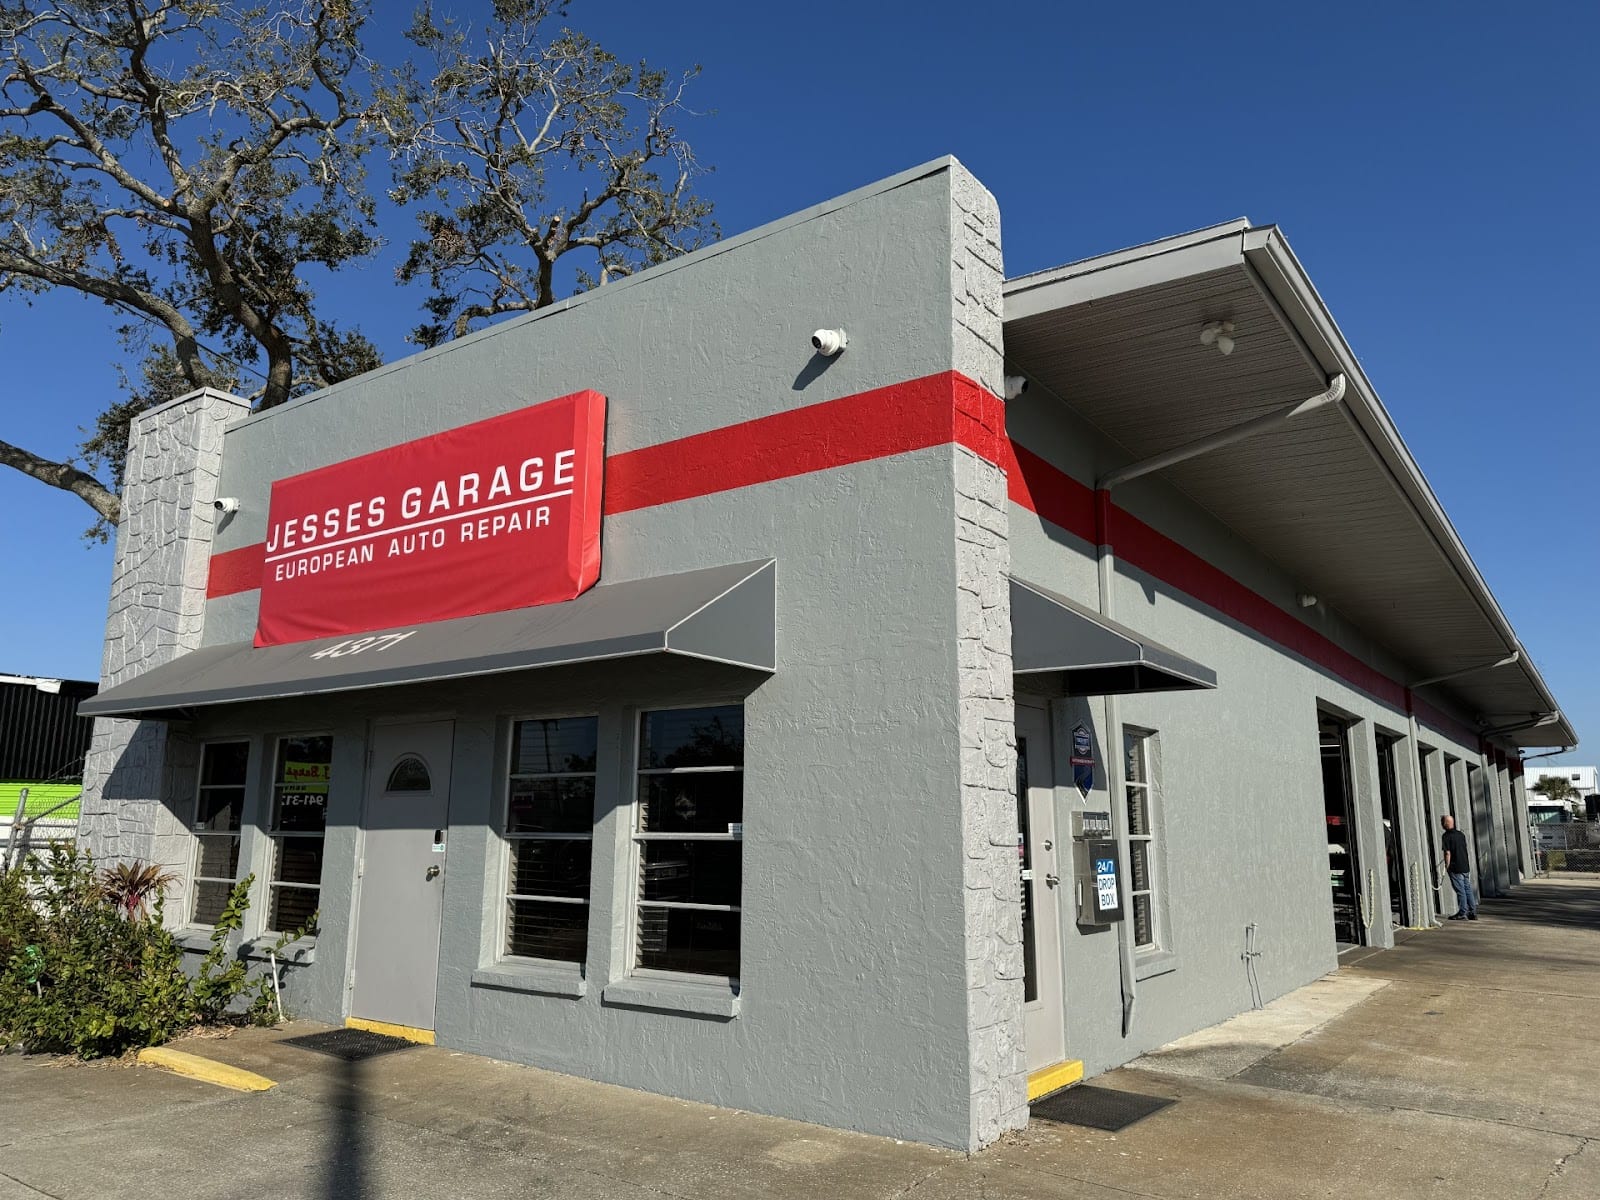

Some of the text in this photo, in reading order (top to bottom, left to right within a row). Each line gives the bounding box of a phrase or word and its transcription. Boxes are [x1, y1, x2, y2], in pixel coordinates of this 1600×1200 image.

[265, 448, 576, 553] JESSES GARAGE
[275, 506, 551, 582] EUROPEAN AUTO REPAIR
[309, 630, 418, 660] 4371
[1097, 860, 1114, 874] 24/7
[1098, 877, 1115, 891] DROP
[1101, 893, 1115, 906] BOX
